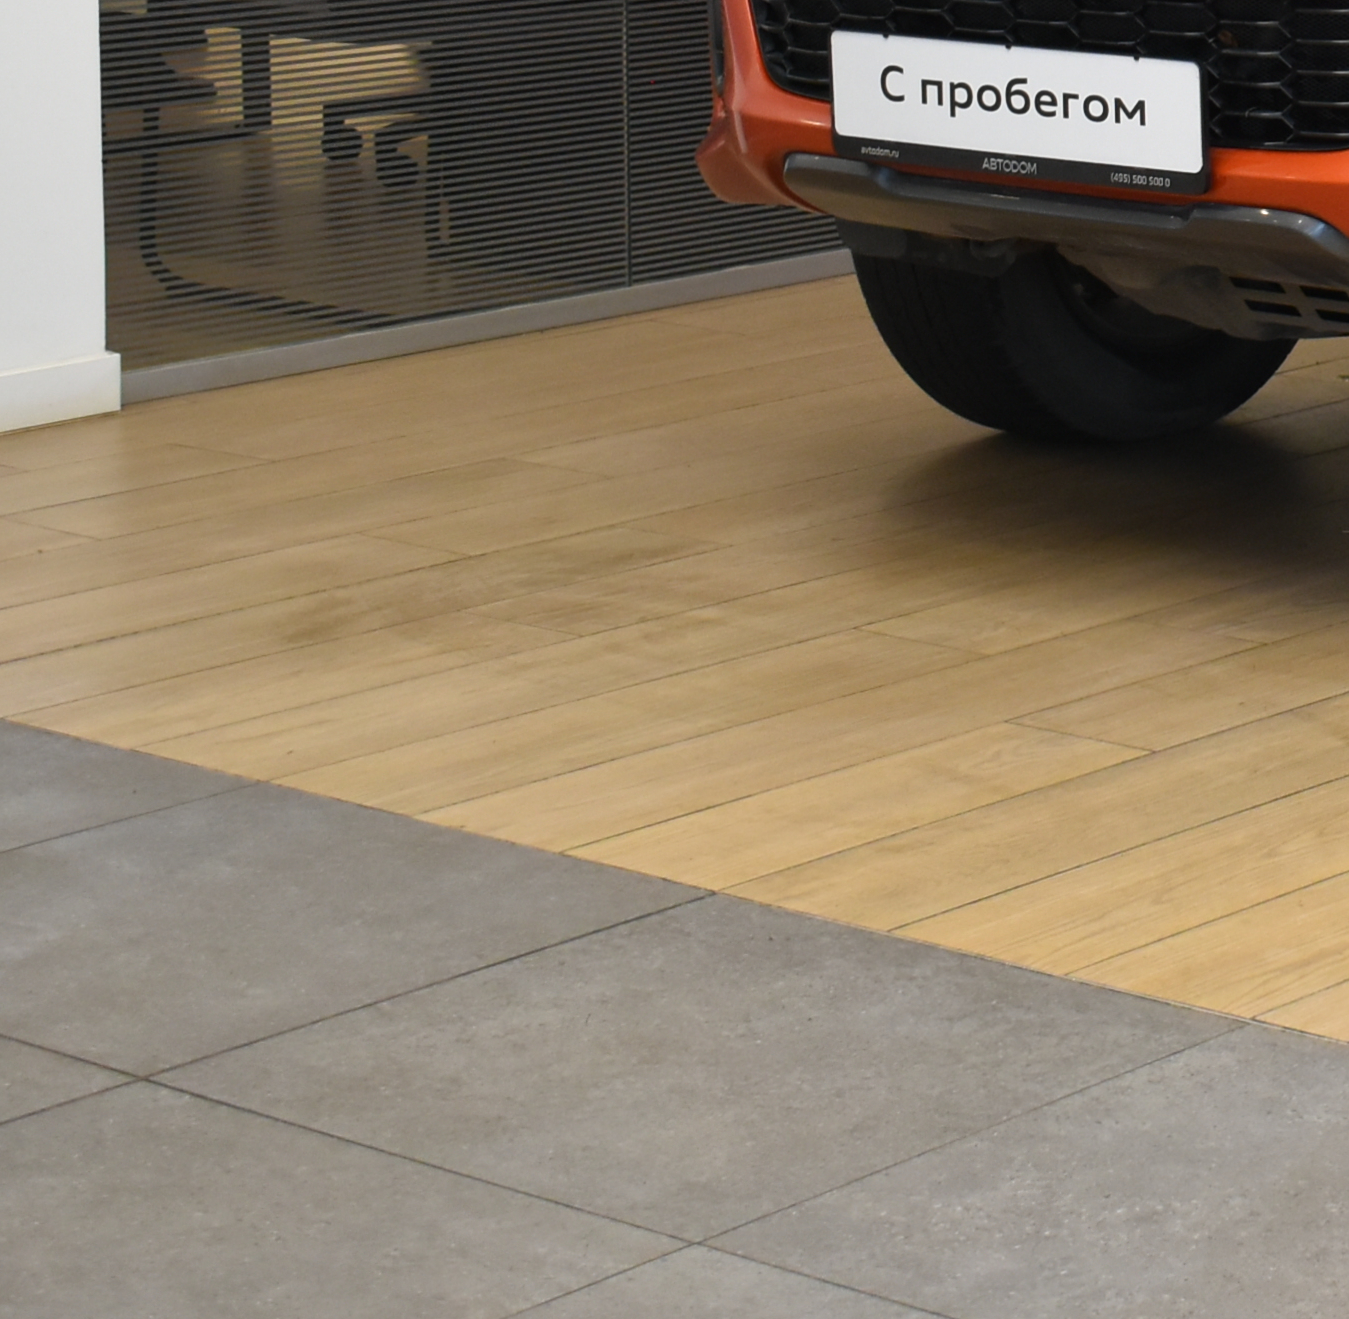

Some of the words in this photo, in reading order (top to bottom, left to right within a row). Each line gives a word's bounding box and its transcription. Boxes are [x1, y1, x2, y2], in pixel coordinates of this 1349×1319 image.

[880, 64, 905, 102] С
[920, 77, 1147, 127] пробегом
[860, 145, 900, 159] avtodom.ru
[1110, 171, 1131, 185] (495)
[1132, 174, 1148, 185] 500
[1148, 175, 1164, 187] 500
